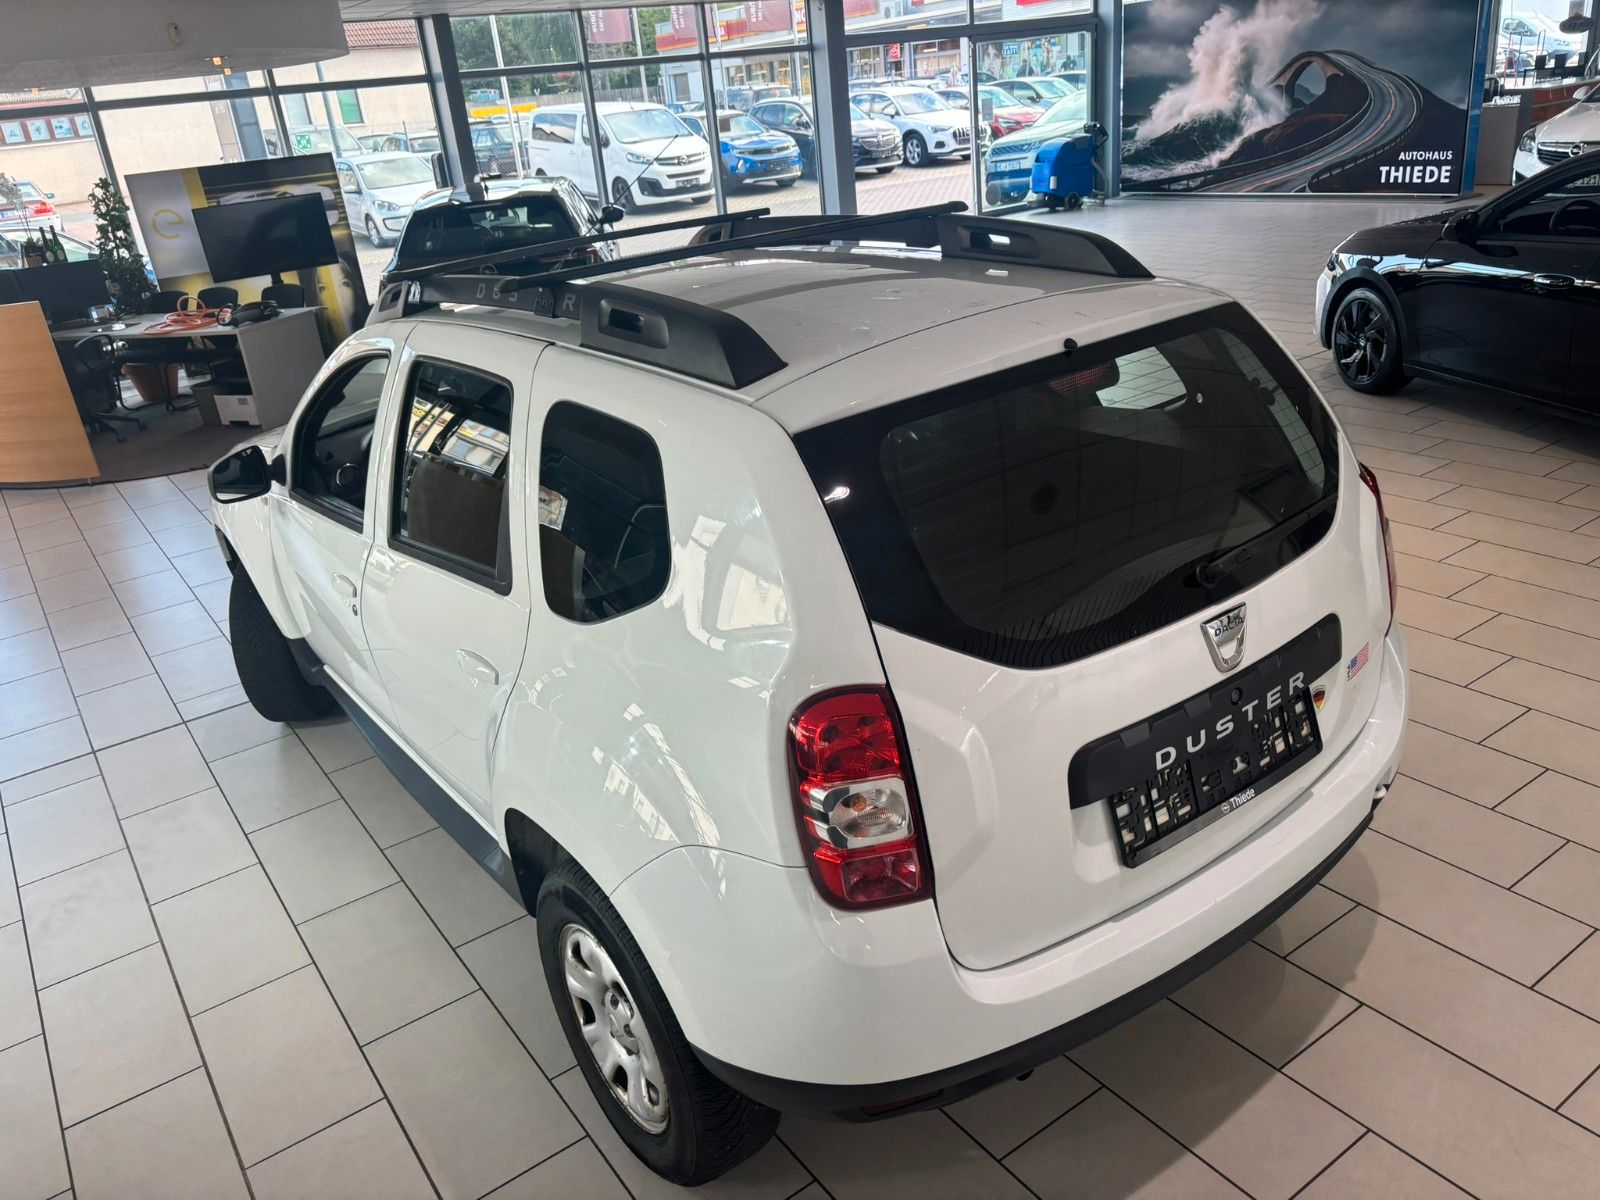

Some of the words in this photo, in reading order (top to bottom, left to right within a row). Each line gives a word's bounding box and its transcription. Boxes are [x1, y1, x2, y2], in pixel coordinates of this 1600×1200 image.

[1398, 150, 1453, 161] AUTOHAUS
[1379, 165, 1452, 183] THIEDE
[1214, 616, 1244, 637] DACIA
[1155, 671, 1305, 770] DUSTER
[1229, 787, 1256, 810] Thiede
